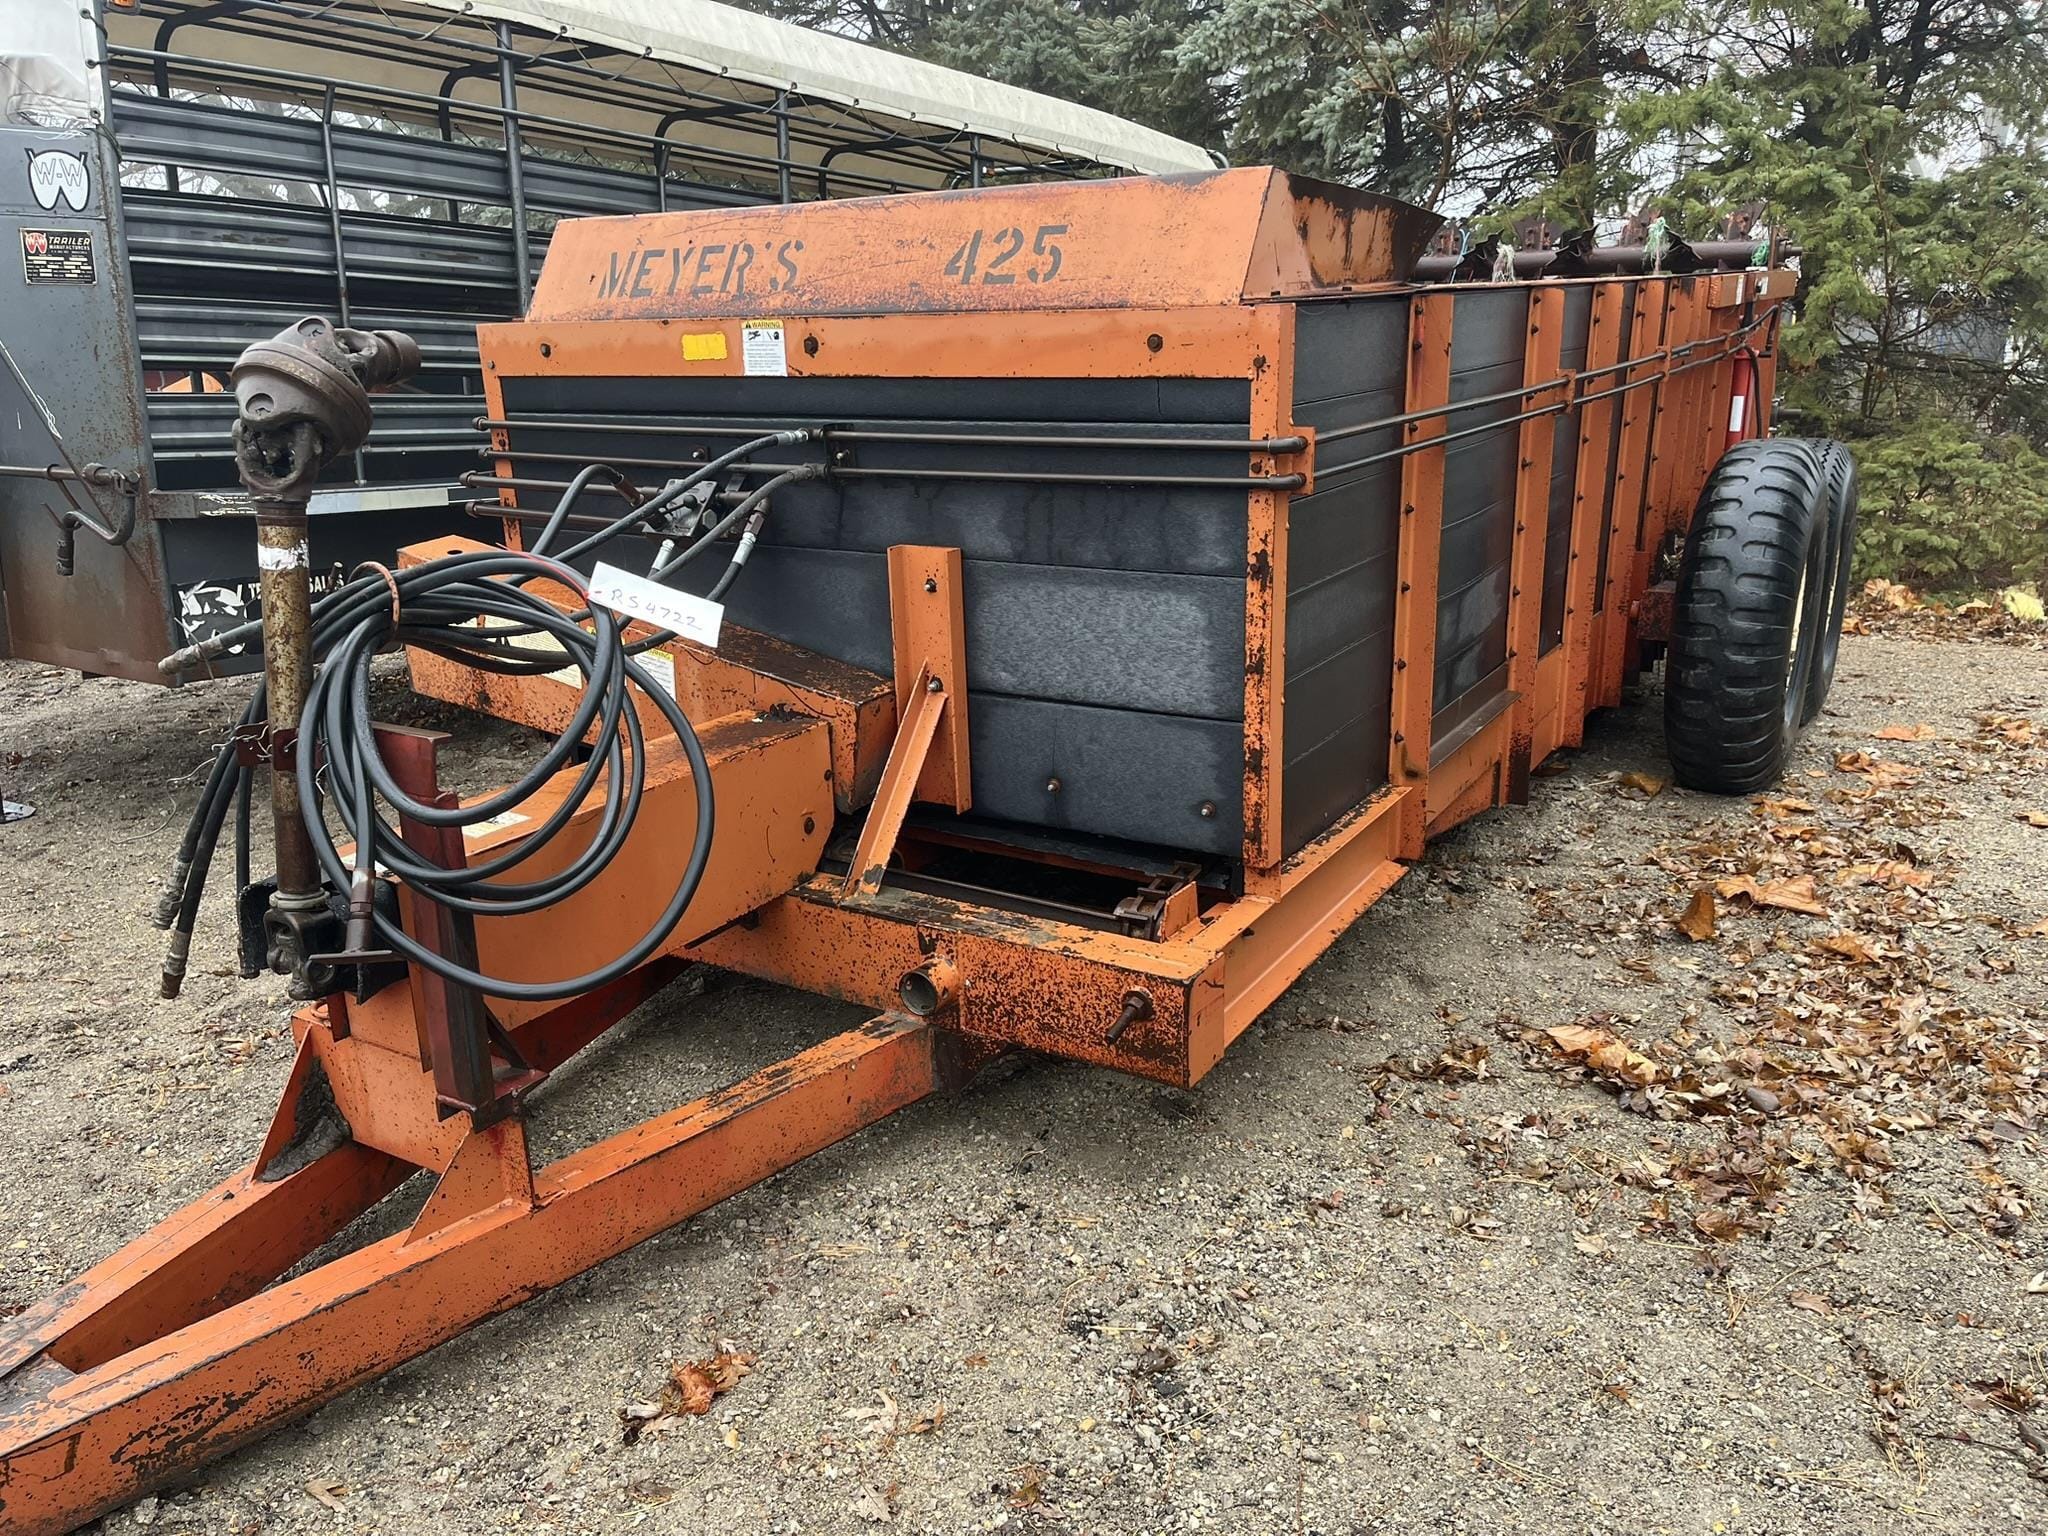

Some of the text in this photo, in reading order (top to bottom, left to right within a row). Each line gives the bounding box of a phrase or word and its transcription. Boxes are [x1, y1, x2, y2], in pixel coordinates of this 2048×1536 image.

[48, 236, 90, 245] TRAILER
[597, 224, 1069, 299] MEYER'S 425
[752, 321, 781, 329] WARNING
